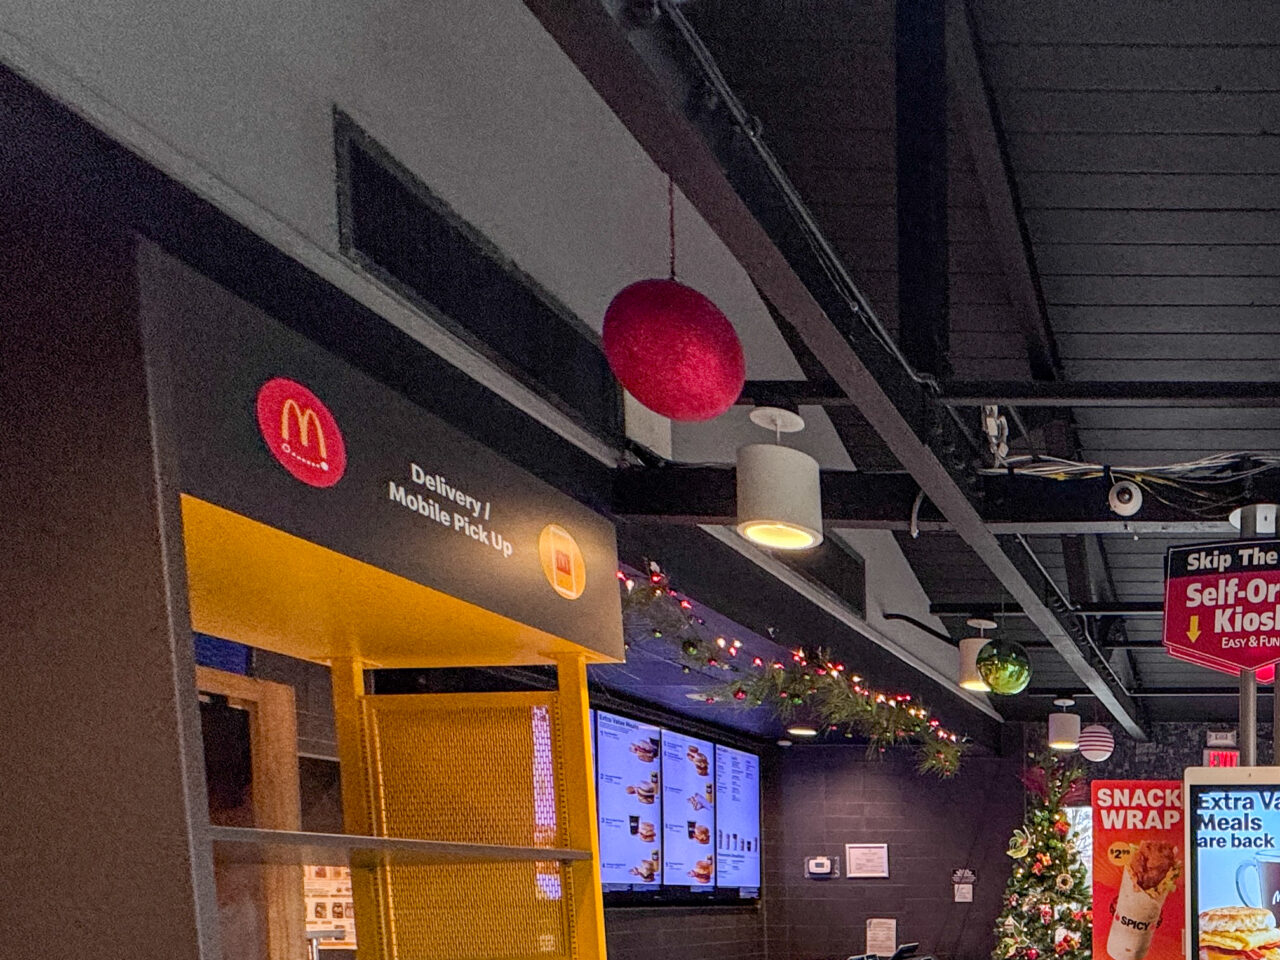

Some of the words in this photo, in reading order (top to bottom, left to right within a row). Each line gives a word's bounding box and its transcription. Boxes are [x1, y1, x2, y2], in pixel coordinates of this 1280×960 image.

[411, 462, 481, 518] Delivery
[389, 481, 451, 526] Mobile
[454, 513, 489, 545] Pick
[491, 531, 513, 558] Up
[1187, 551, 1232, 572] Skip
[1238, 547, 1277, 566] The
[1222, 637, 1247, 649] EASY
[1248, 636, 1258, 648] &
[1097, 788, 1182, 808] SNACK
[1198, 793, 1255, 811] Extra
[1100, 809, 1181, 830] WRAP
[1198, 813, 1262, 831] Meals
[1198, 836, 1227, 848] are
[1231, 832, 1275, 848] back
[1121, 916, 1150, 931] SPICY
